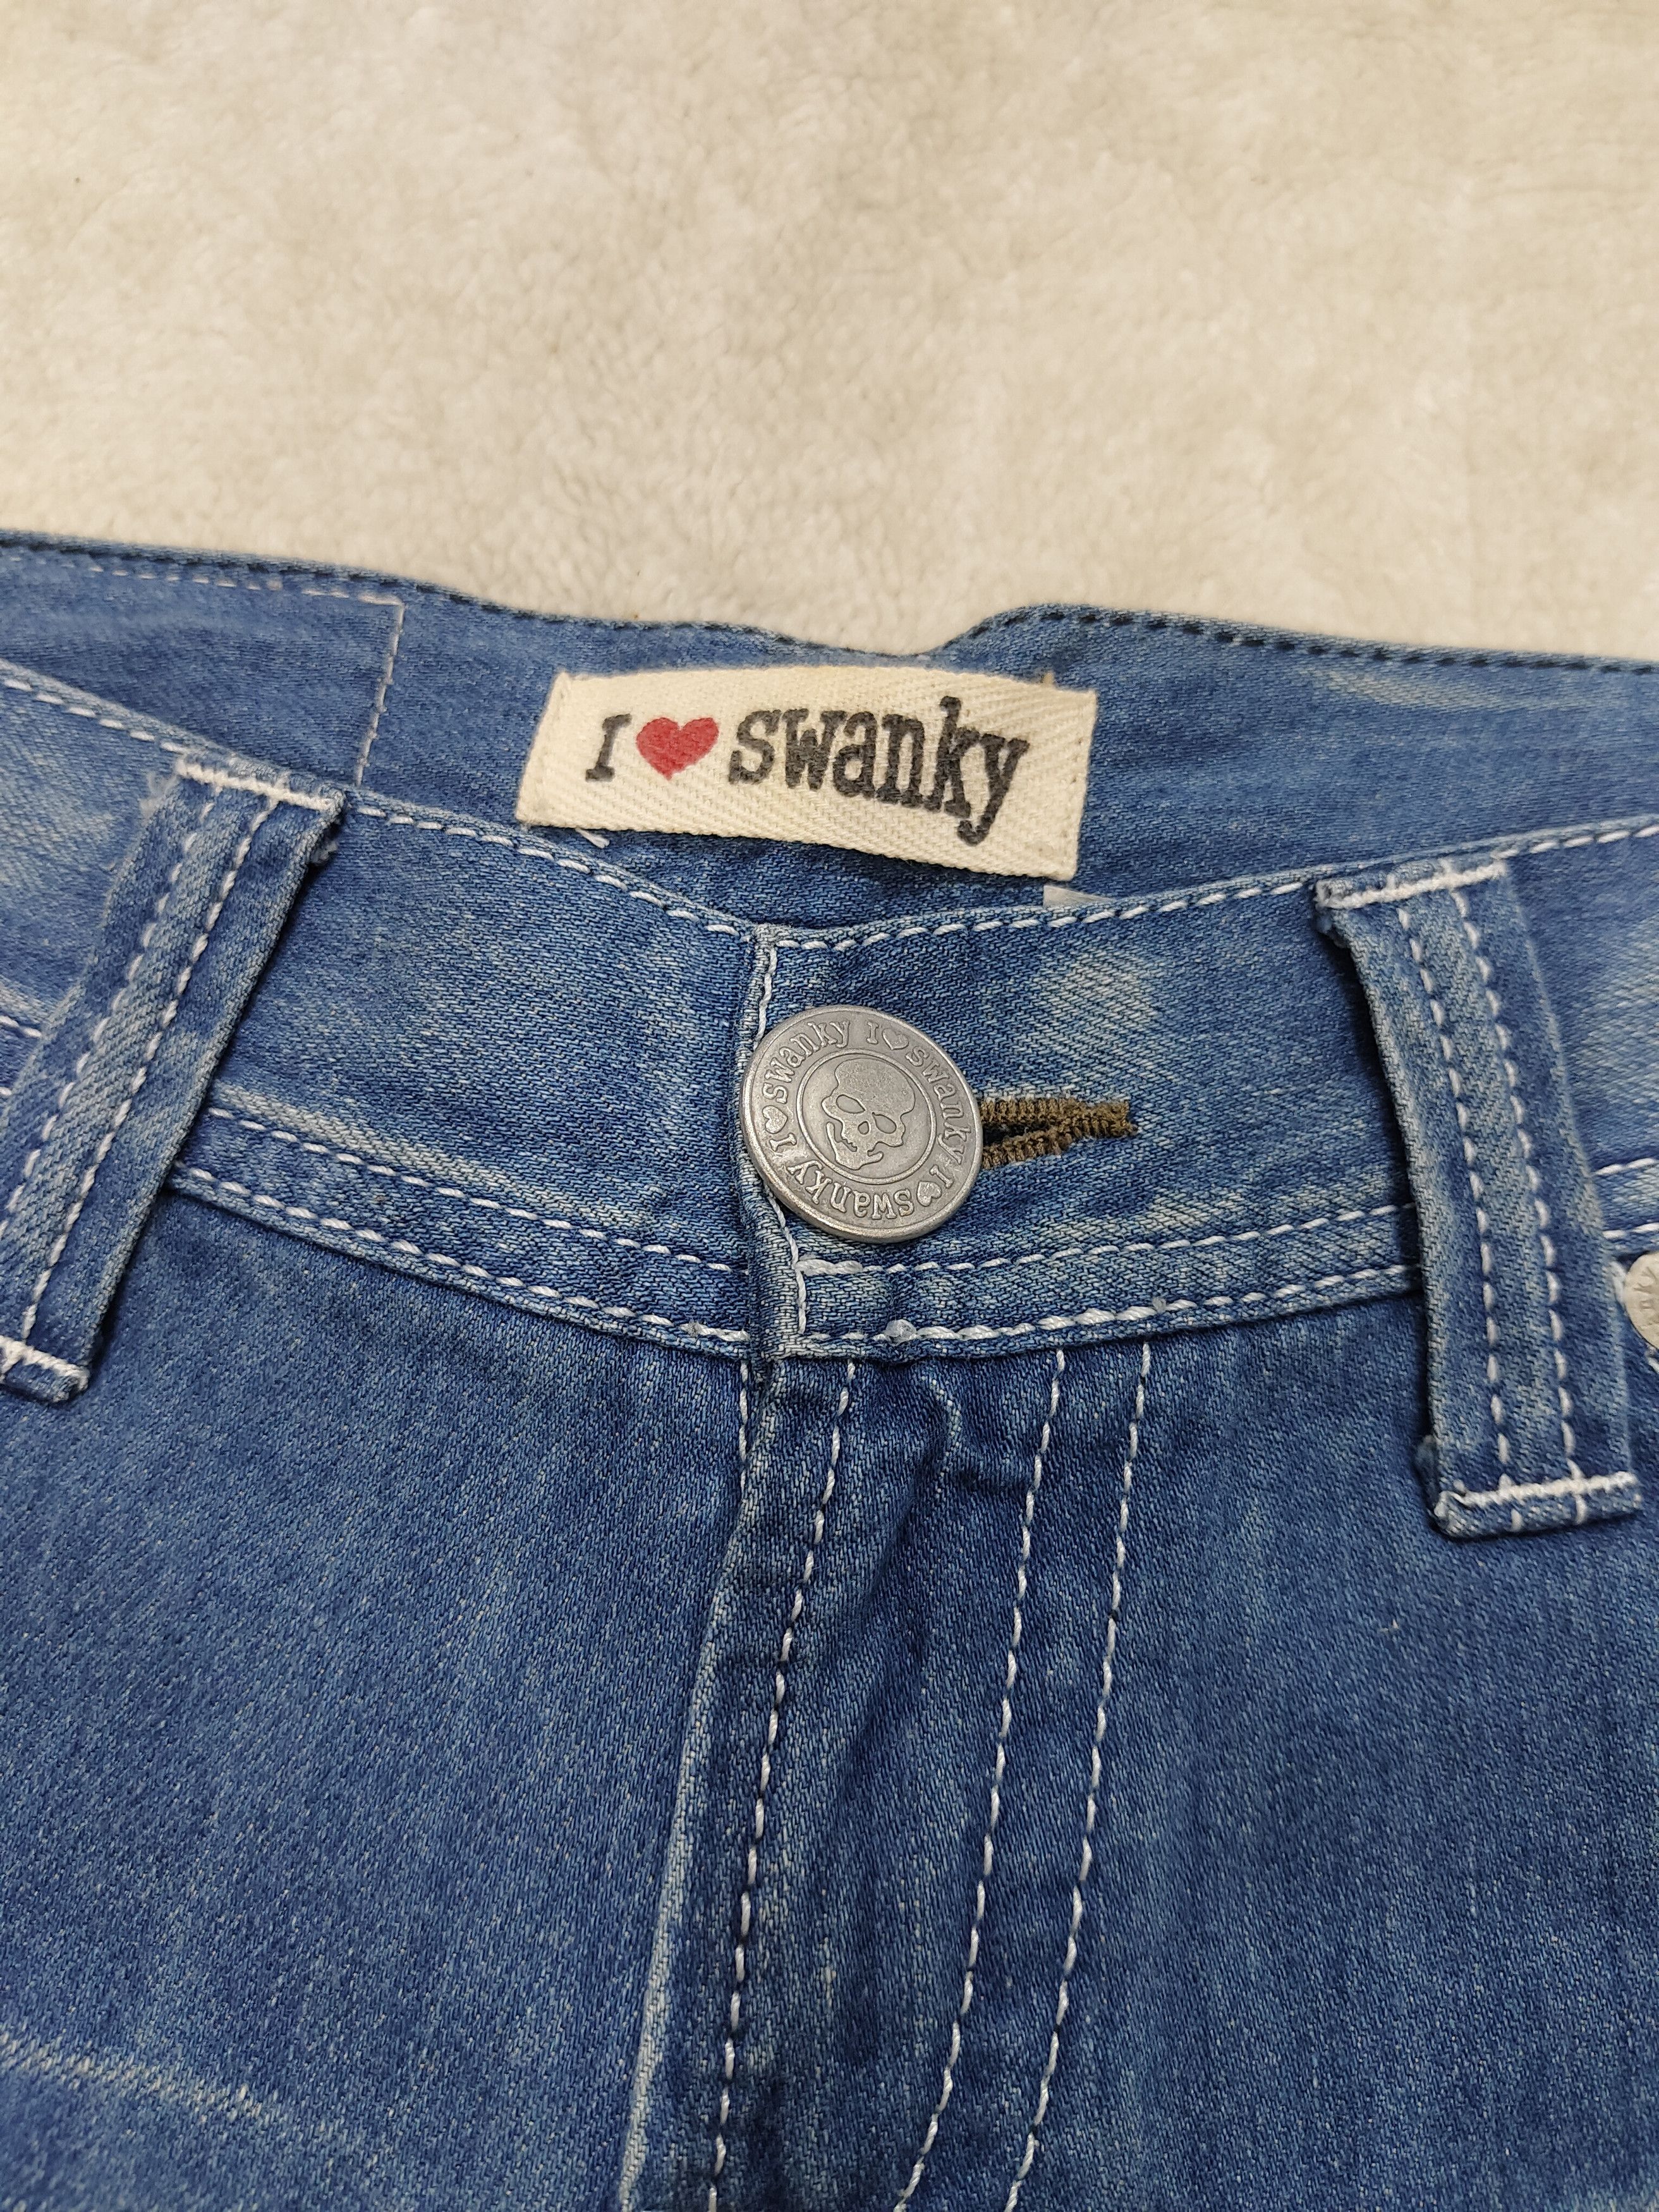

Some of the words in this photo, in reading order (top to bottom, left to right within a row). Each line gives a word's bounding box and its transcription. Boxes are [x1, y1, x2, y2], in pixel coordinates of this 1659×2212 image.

[585, 713, 631, 782] I
[727, 695, 1030, 846] swanky
[762, 1019, 851, 1105] swanky
[866, 1020, 880, 1045] I
[905, 1045, 972, 1165] swanky
[769, 1132, 797, 1152] I
[930, 1164, 954, 1189] I
[785, 1160, 915, 1220] swanky
